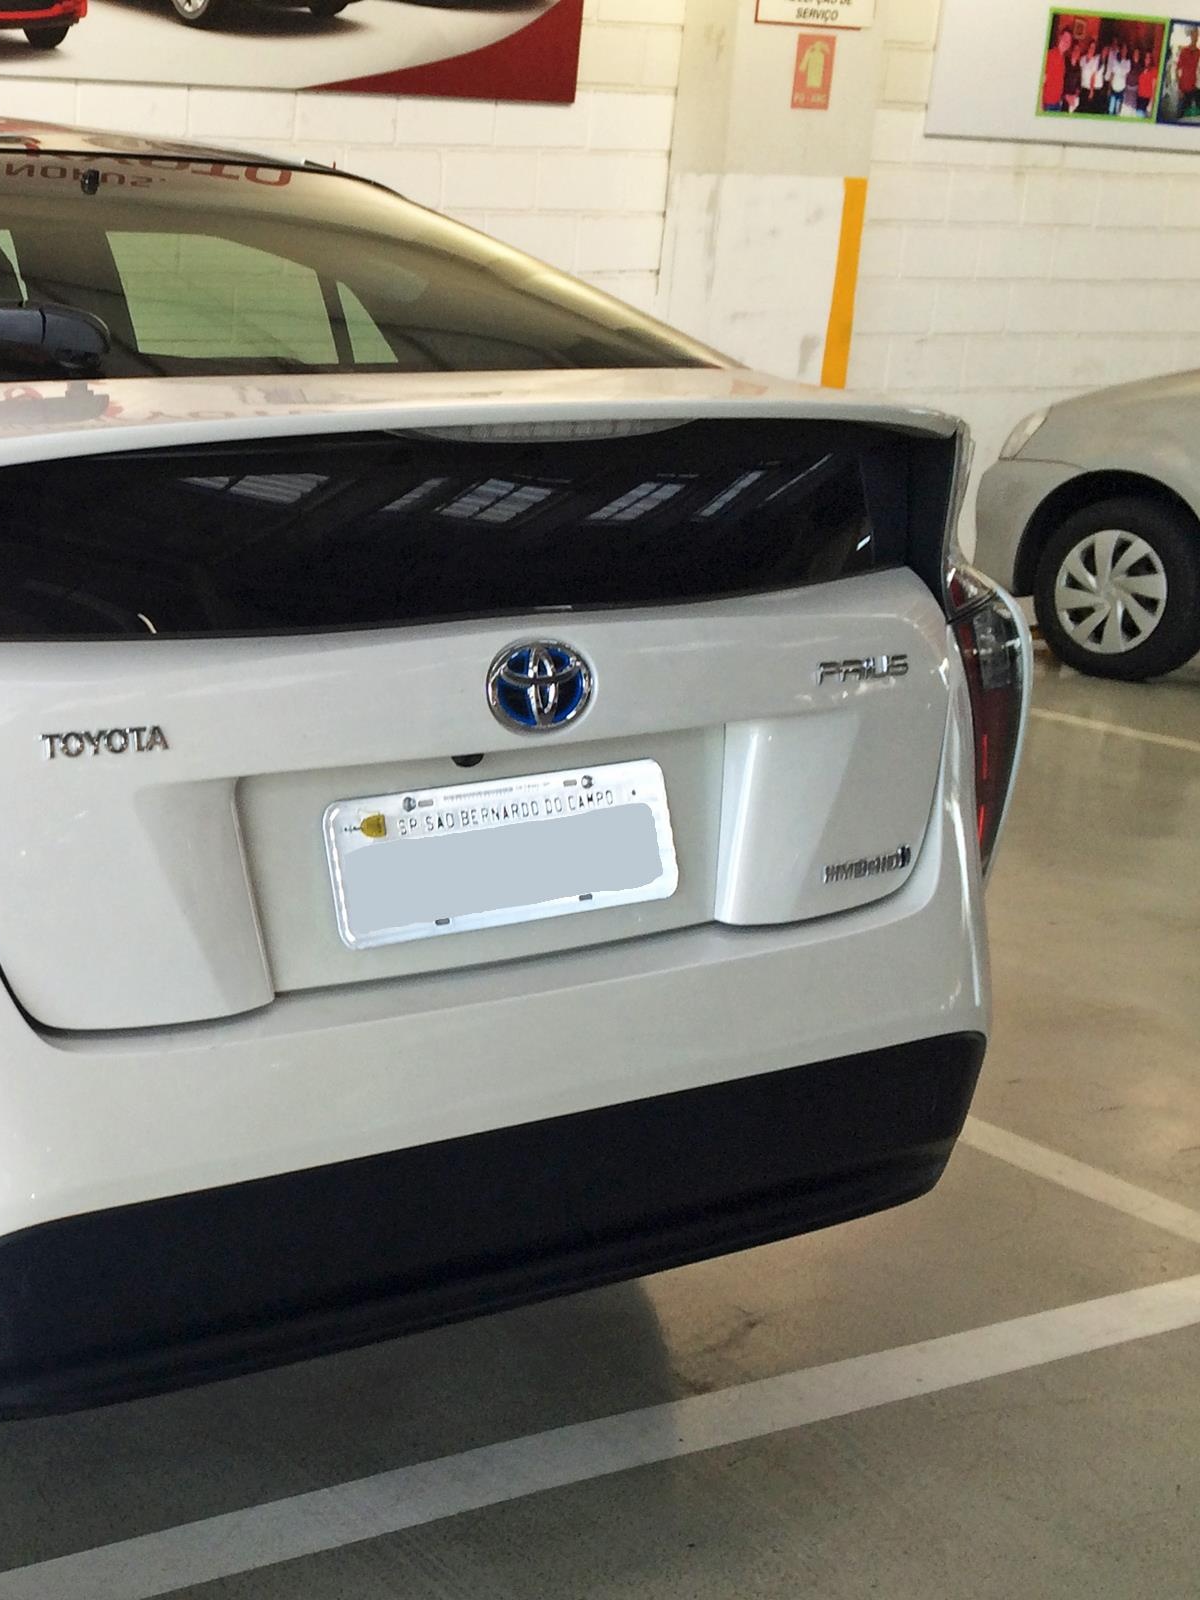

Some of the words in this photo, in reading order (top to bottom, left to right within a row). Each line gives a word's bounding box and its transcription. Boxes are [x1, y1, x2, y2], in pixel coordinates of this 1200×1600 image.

[796, 7, 839, 22] SERVIÇO
[816, 655, 908, 685] PRIUS
[40, 726, 169, 759] TOYOTA
[398, 818, 417, 836] SP
[460, 800, 540, 828] BERNARDO
[545, 797, 563, 815] DO
[568, 789, 614, 811] CAMPO
